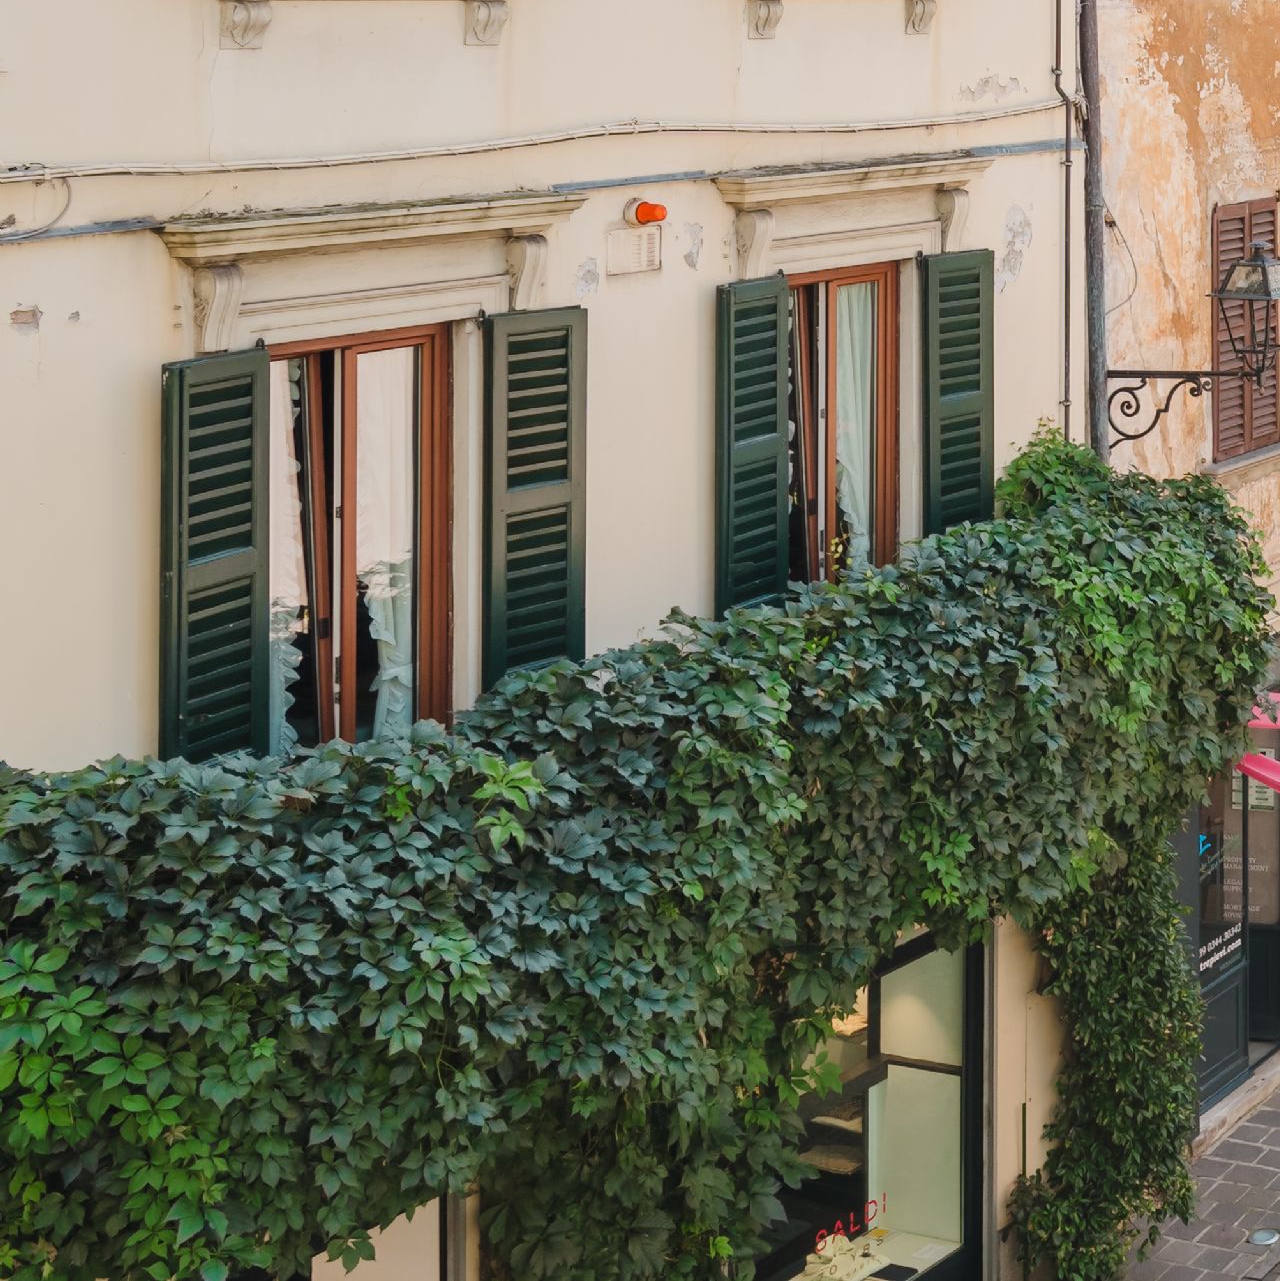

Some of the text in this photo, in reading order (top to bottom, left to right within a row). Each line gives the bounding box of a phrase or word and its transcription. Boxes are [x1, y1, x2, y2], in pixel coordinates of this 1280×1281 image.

[1223, 855, 1257, 864] PROPTY
[1223, 863, 1269, 872] MANAEMENT
[1223, 903, 1260, 912] MORTAGE
[816, 1192, 886, 1254] SALDI
